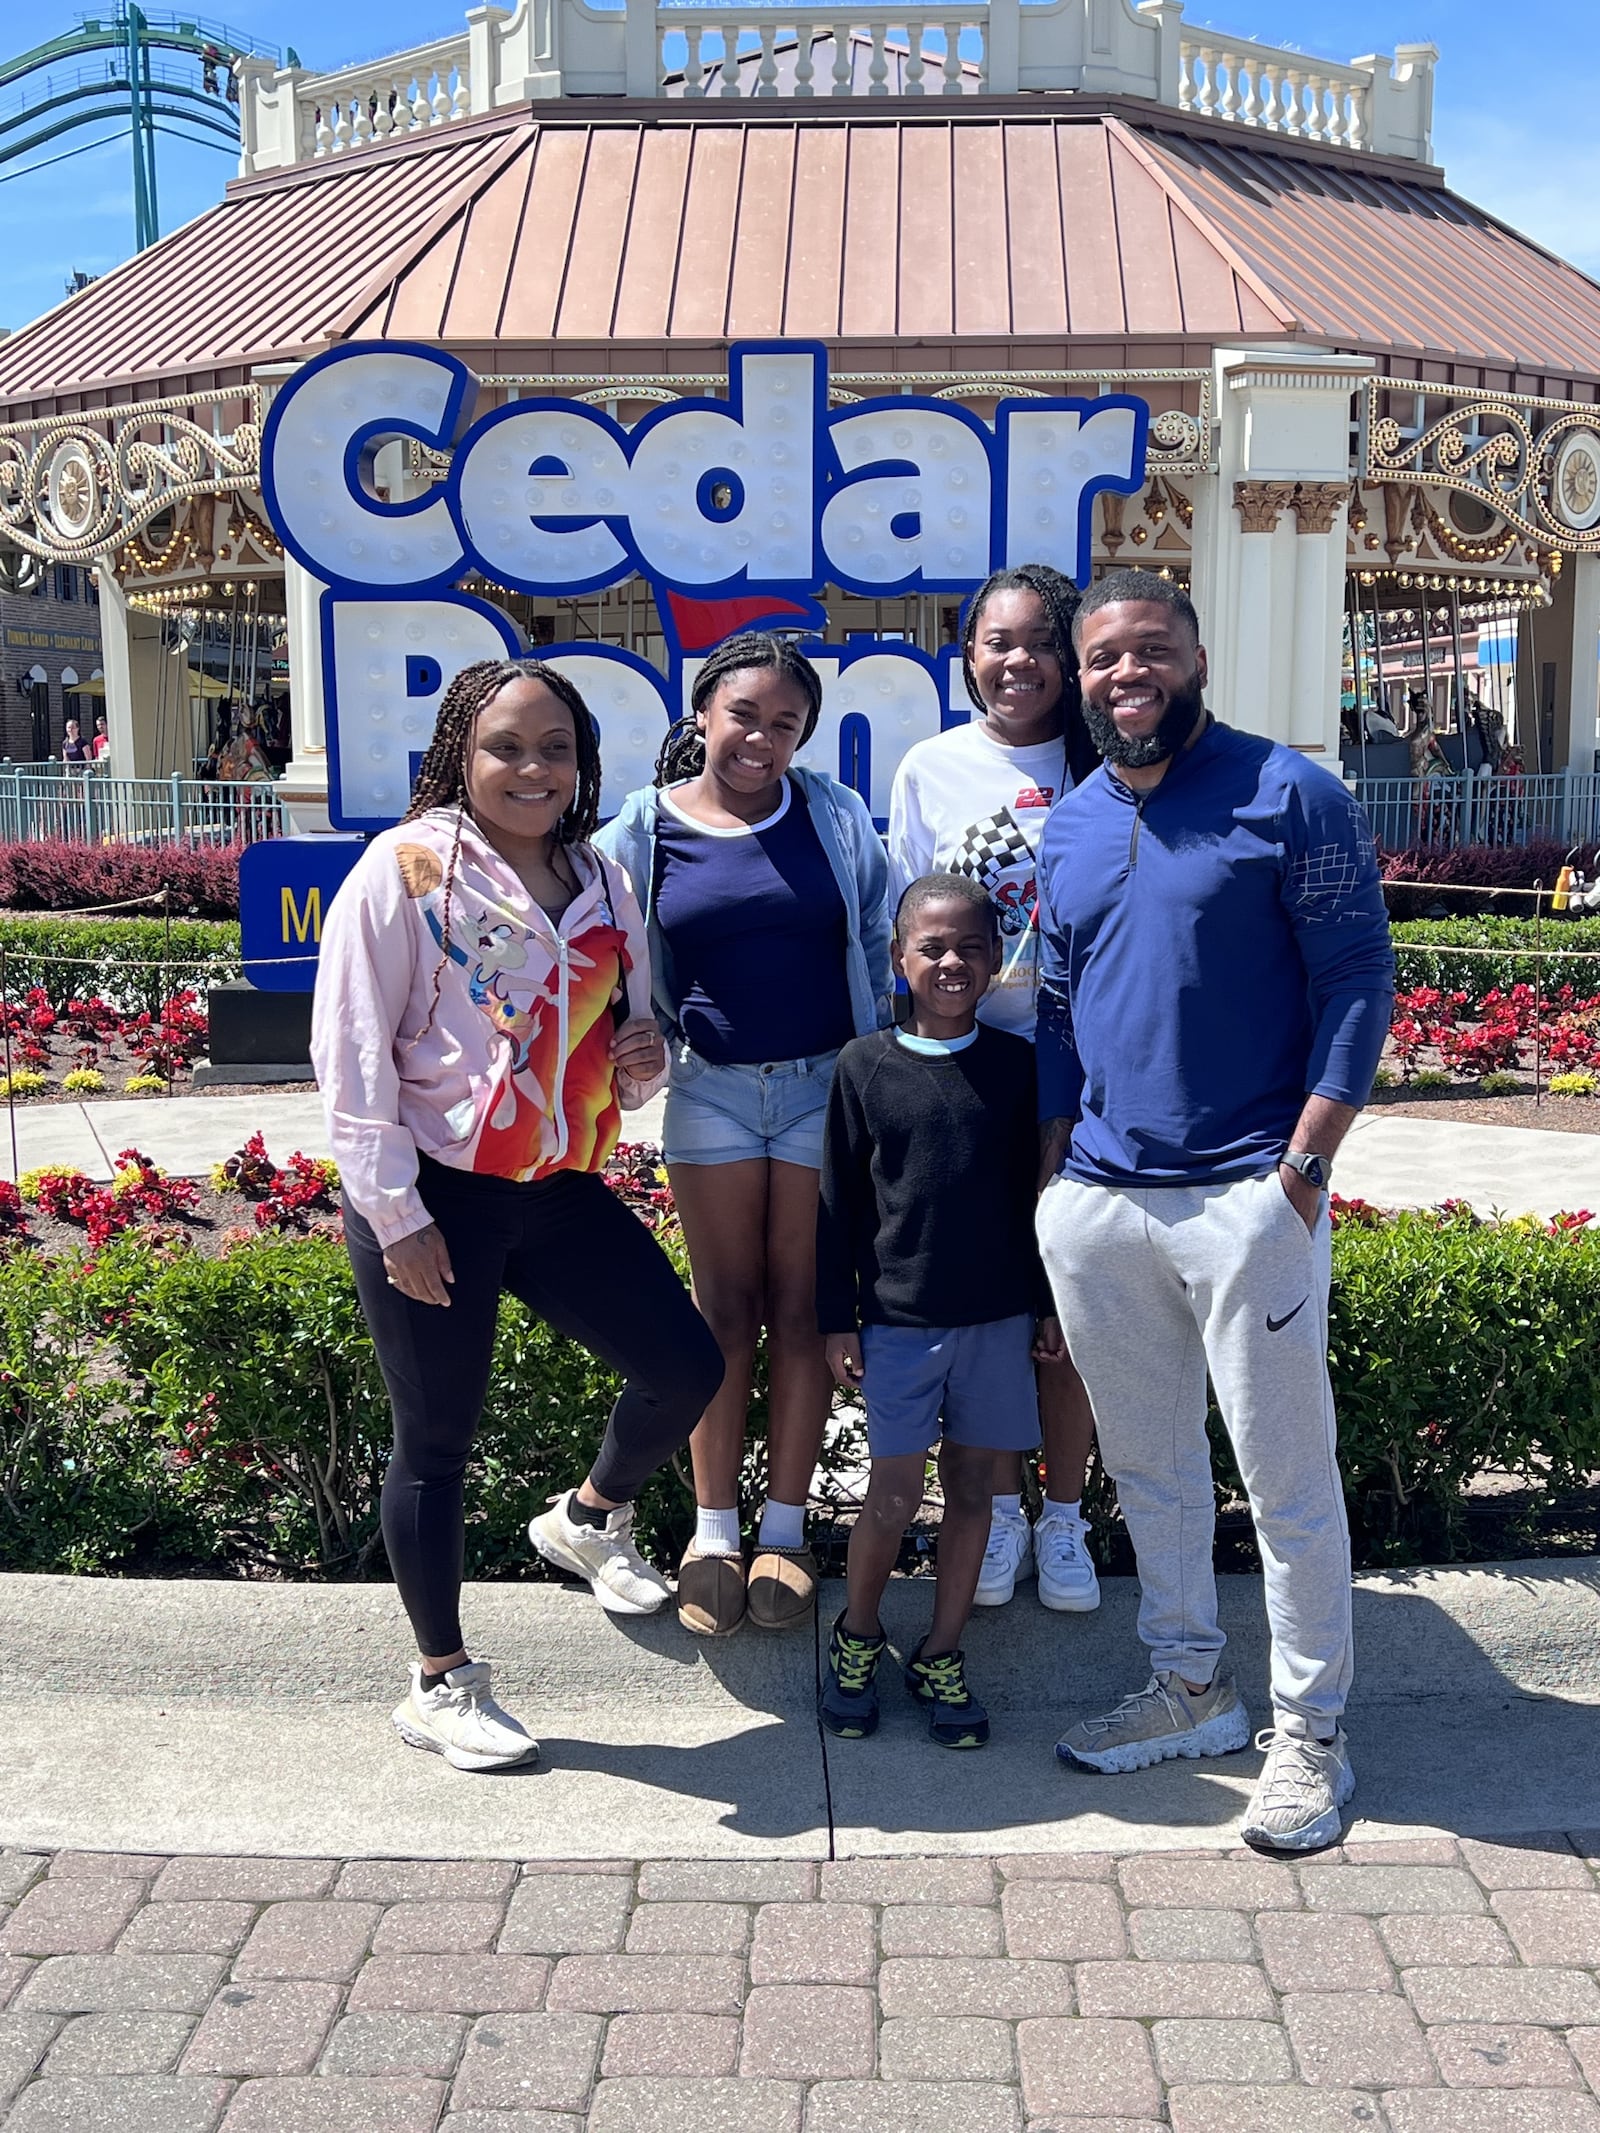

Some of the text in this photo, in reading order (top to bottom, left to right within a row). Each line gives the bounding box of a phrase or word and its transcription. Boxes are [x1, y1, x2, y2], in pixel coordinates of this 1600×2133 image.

[265, 344, 1143, 590] Cedar
[329, 592, 984, 822] Pon
[1014, 786, 1055, 809] 22
